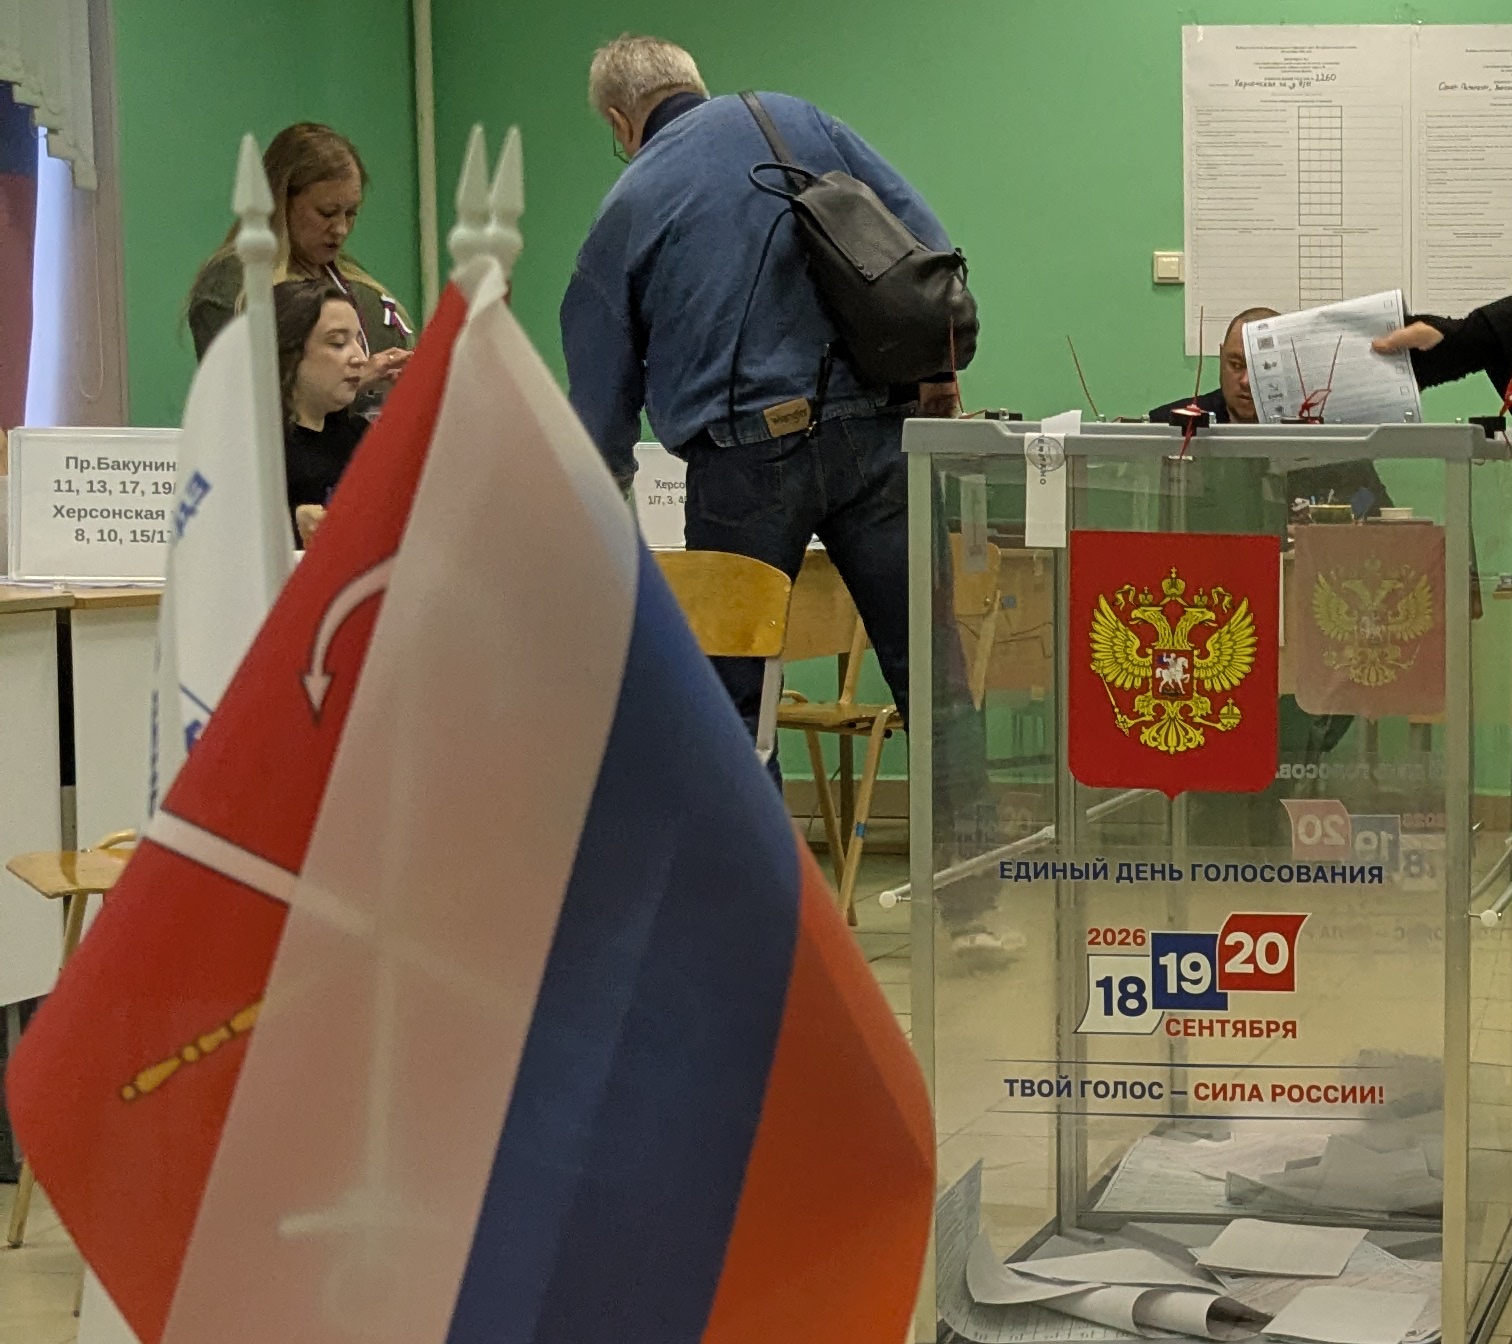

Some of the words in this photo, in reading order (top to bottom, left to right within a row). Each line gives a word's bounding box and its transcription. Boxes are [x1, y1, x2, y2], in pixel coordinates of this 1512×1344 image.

[1315, 73, 1336, 82] 2260
[65, 456, 178, 474] Пр.Бакунин
[53, 479, 80, 495] 11,
[86, 480, 113, 496] 13,
[119, 480, 145, 496] 17,
[53, 504, 166, 523] Херсонская
[74, 528, 90, 544] 8,
[97, 528, 123, 544] 10,
[130, 529, 172, 544] 15/1
[1000, 858, 1108, 882] ЕДИНЫЙ
[1116, 863, 1184, 884] ДЕНЬ
[1191, 863, 1384, 885] ГОЛОСОВАНИЯ
[1088, 928, 1146, 946] 2026
[1095, 976, 1148, 1018] 18
[1159, 952, 1212, 994] 19
[1224, 931, 1290, 974] 20
[1165, 1018, 1298, 1040] СЕНТЯБРЯ
[1004, 1074, 1072, 1098] ТВОЙ
[1080, 1080, 1164, 1100] ГОЛОС
[1193, 1082, 1264, 1103] СИЛА
[1272, 1084, 1385, 1104] РОССИИ!
